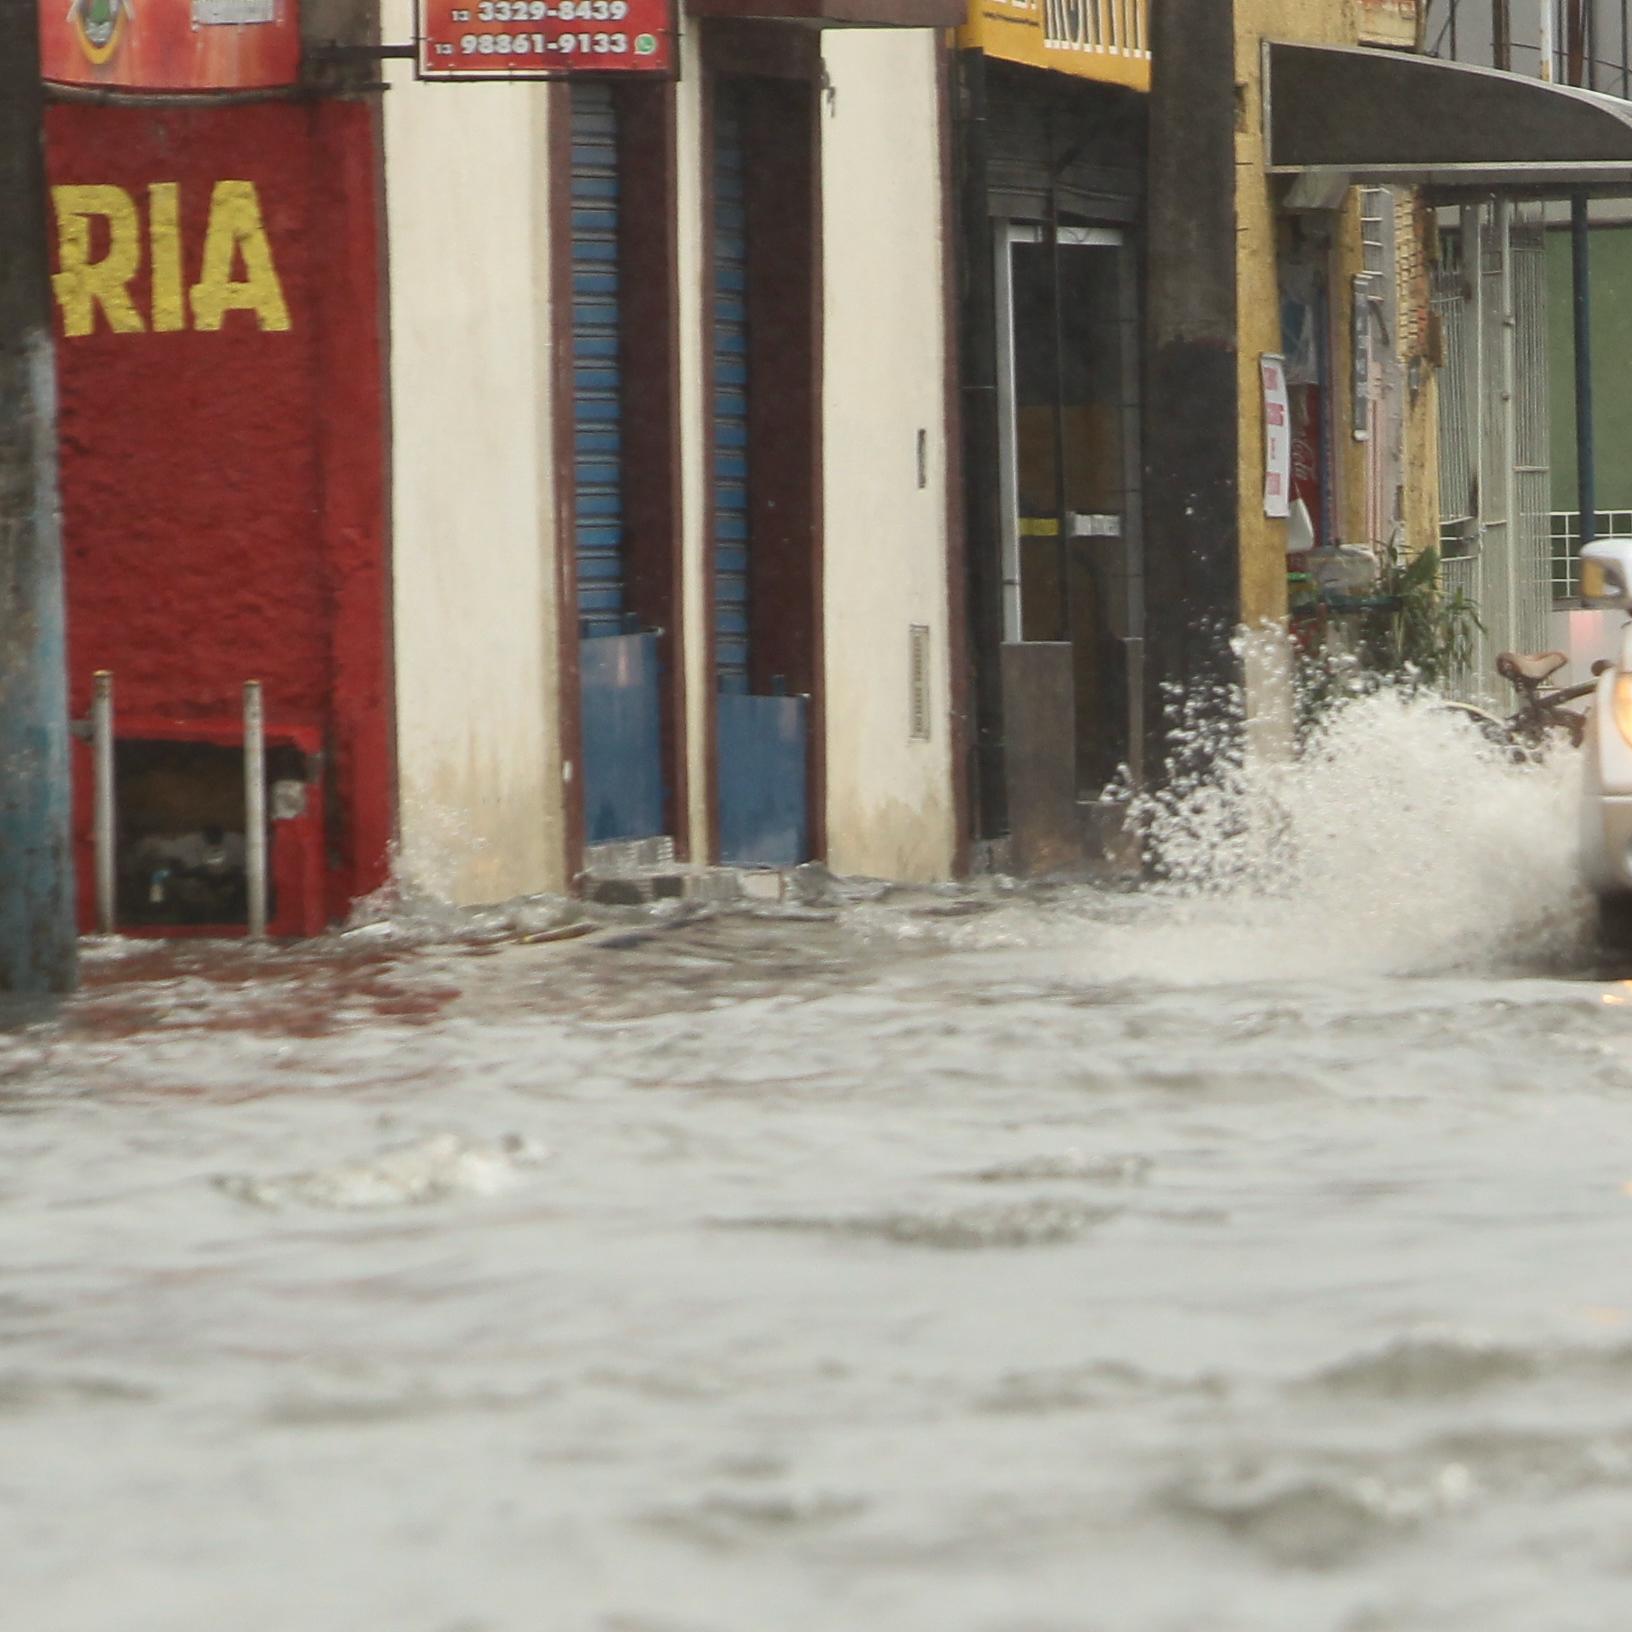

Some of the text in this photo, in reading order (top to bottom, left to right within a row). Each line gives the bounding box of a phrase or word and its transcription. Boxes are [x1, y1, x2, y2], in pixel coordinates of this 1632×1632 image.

[478, 0, 628, 21] 3329-8439
[460, 33, 628, 54] 98861-9133
[51, 180, 293, 337] RIA
